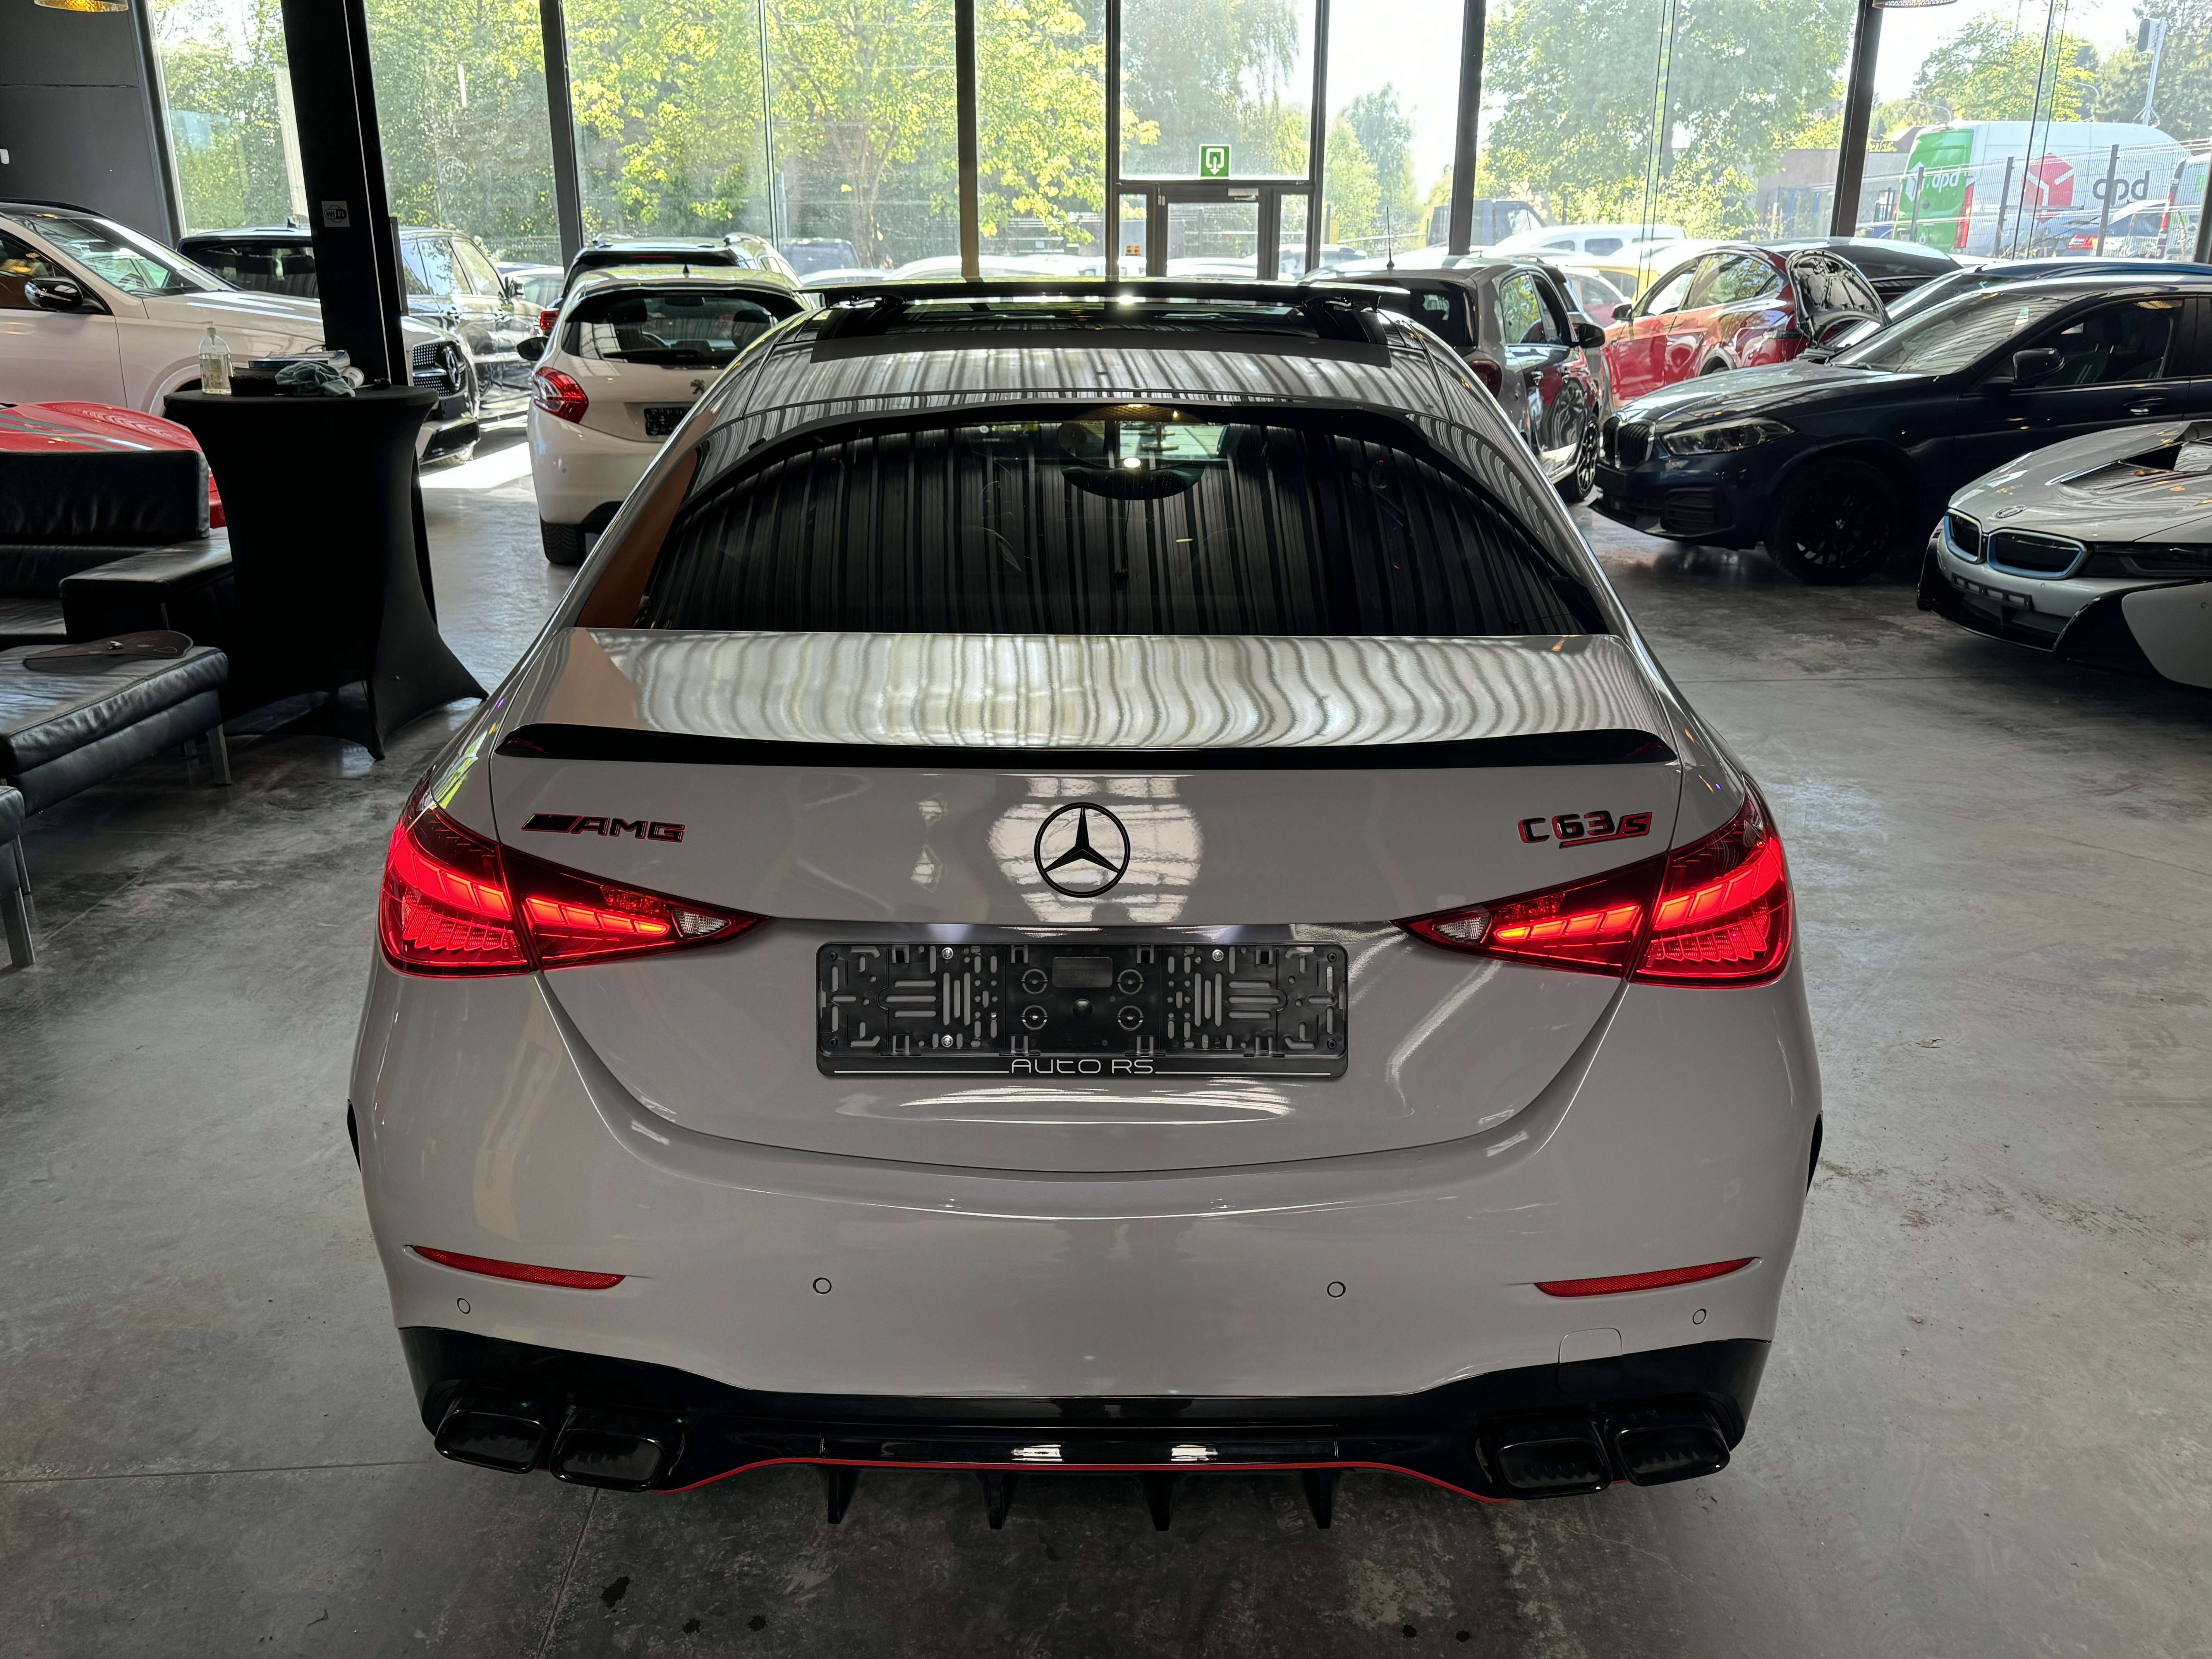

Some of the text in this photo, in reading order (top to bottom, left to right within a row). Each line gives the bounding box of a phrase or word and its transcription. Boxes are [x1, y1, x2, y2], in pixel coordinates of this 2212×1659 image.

[1932, 167, 1961, 193] dpd
[570, 816, 685, 843] AMG
[1112, 1059, 1154, 1074] RS
